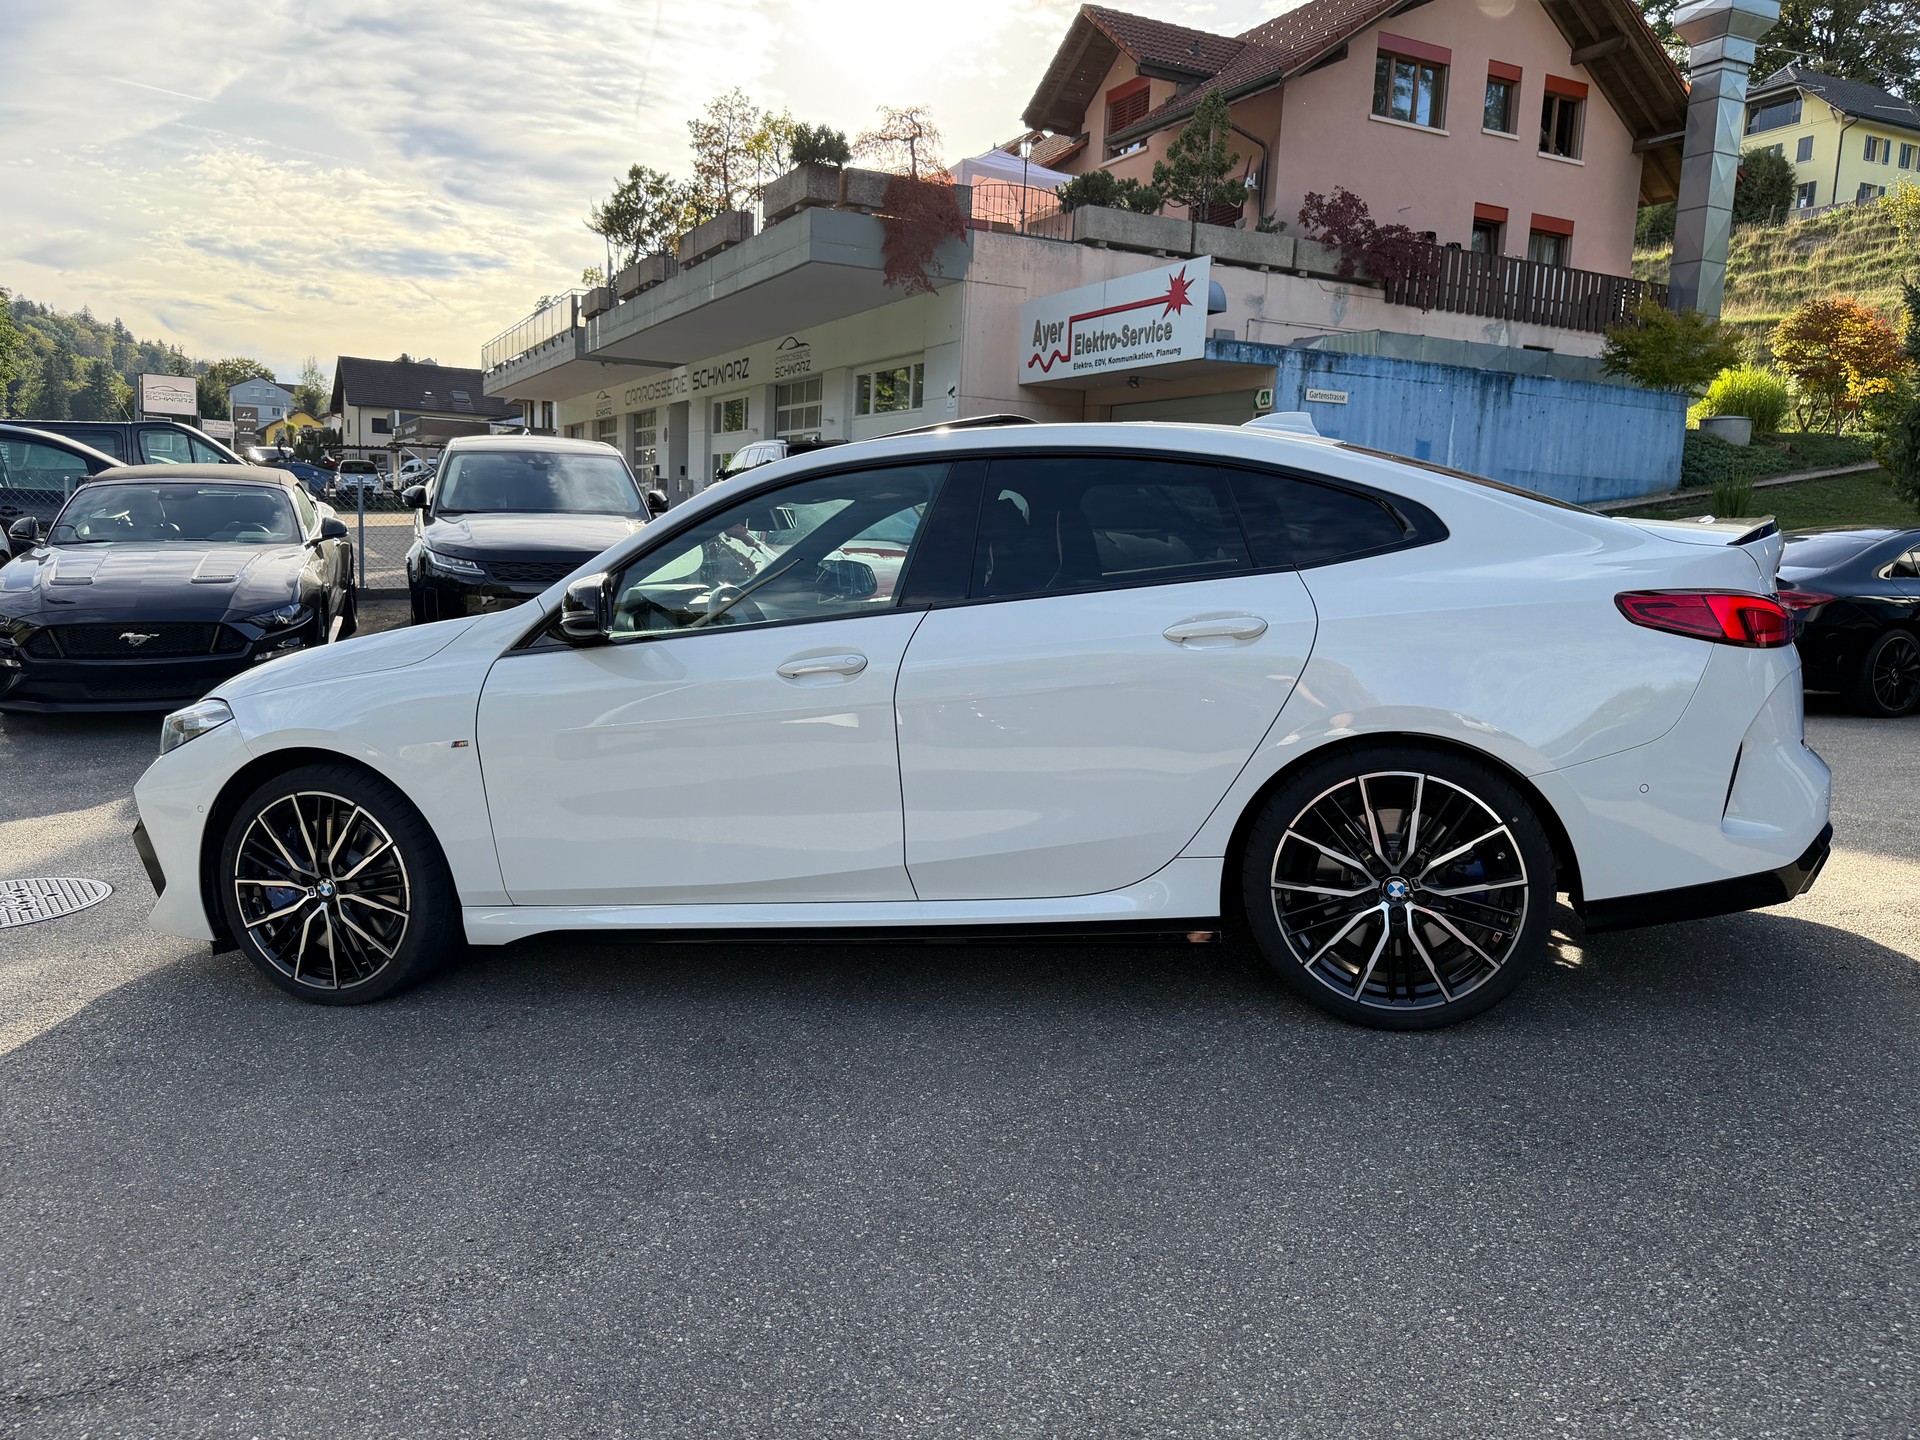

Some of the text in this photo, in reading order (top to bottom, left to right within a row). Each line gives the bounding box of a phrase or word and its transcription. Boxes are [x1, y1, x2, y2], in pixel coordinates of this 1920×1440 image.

[1032, 319, 1065, 352] Ayer
[1074, 319, 1173, 355] Elektro-Service
[775, 349, 811, 365] CARROSSERIE
[1073, 347, 1182, 370] Elektro, EDV, Kommunikation, Planung
[775, 360, 811, 379] SCHWARZ
[624, 357, 749, 406] CARROSSERIE SCHWARZ
[145, 395, 194, 404] SCHWARZ
[1309, 390, 1346, 402] Gartenstrasse
